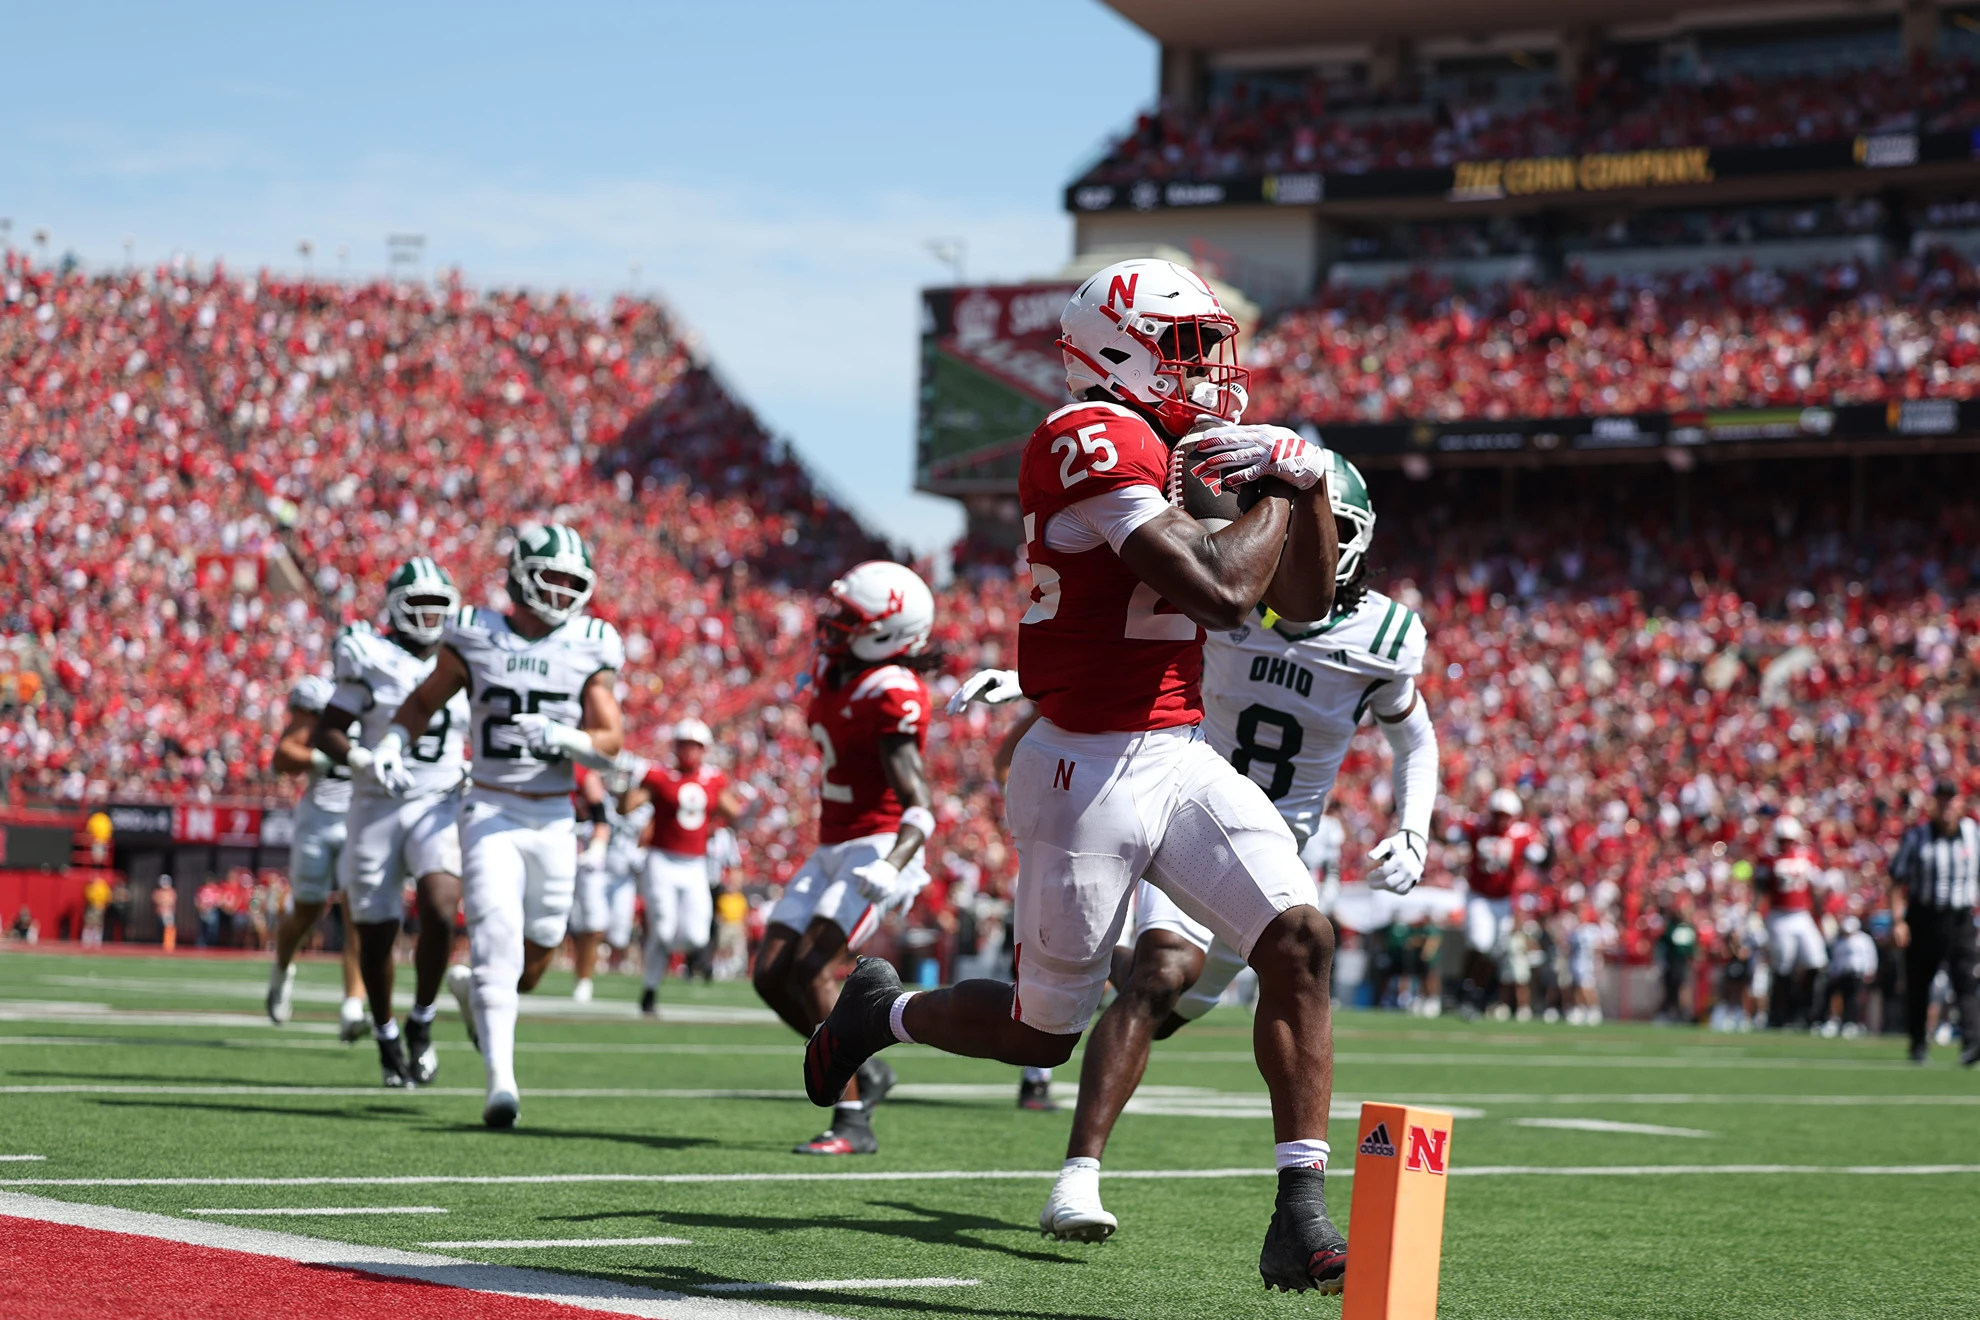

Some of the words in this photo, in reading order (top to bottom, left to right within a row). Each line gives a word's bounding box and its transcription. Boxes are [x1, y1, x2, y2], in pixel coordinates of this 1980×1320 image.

[1503, 157, 1574, 195] CORN
[1107, 273, 1139, 310] N
[1050, 423, 1118, 489] 25
[507, 657, 549, 677] OHIO
[1249, 656, 1314, 698] OHIO
[898, 700, 921, 734] 2
[1231, 702, 1304, 803] 8
[1053, 758, 1076, 791] N
[1360, 1143, 1396, 1157] adidas
[1405, 1124, 1448, 1176] N
